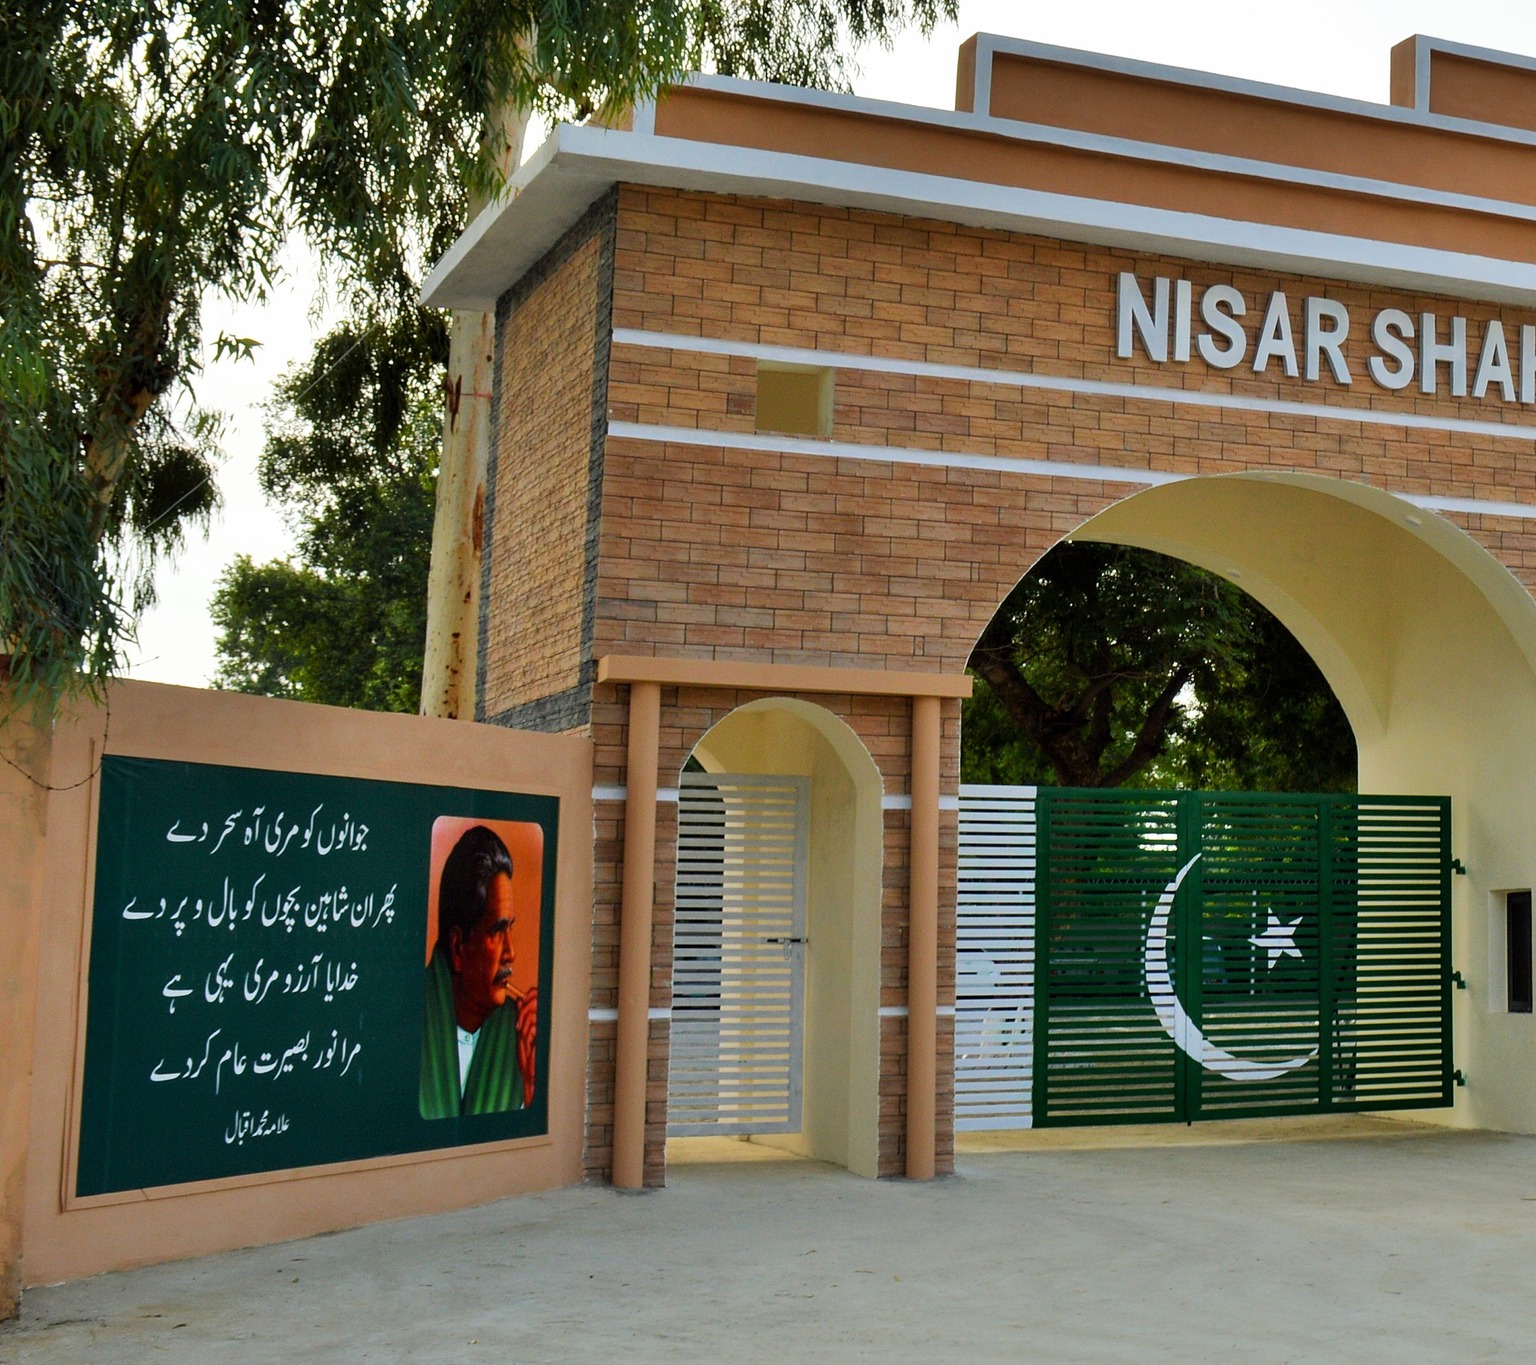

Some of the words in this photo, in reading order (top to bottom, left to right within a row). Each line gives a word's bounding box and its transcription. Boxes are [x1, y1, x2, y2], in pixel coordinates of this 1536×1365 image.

[1116, 271, 1353, 384] NISAR
[166, 820, 208, 842] دے
[210, 809, 242, 855] سحر
[244, 806, 266, 846] آہ
[264, 812, 299, 857] مری
[301, 803, 323, 848] کو
[317, 812, 370, 856] جوانوں
[122, 896, 166, 920] دے
[170, 896, 188, 937] پر
[208, 876, 238, 930] بال
[242, 872, 266, 922] کو
[261, 886, 301, 933] بچوں
[304, 886, 349, 932] شاہین
[350, 892, 374, 928] ان
[372, 883, 398, 928] پھر
[162, 974, 194, 1014] ہے
[204, 952, 234, 1003] یہی
[244, 958, 279, 1005] مری
[282, 952, 323, 994] آرزو
[326, 961, 359, 1002] خدایا
[215, 1042, 247, 1096] عام
[253, 1030, 310, 1080] بصیرت
[312, 1030, 338, 1070] نور
[340, 1038, 362, 1077] مرا
[225, 1110, 255, 1145] اقبال
[262, 1114, 290, 1136] علامہ
